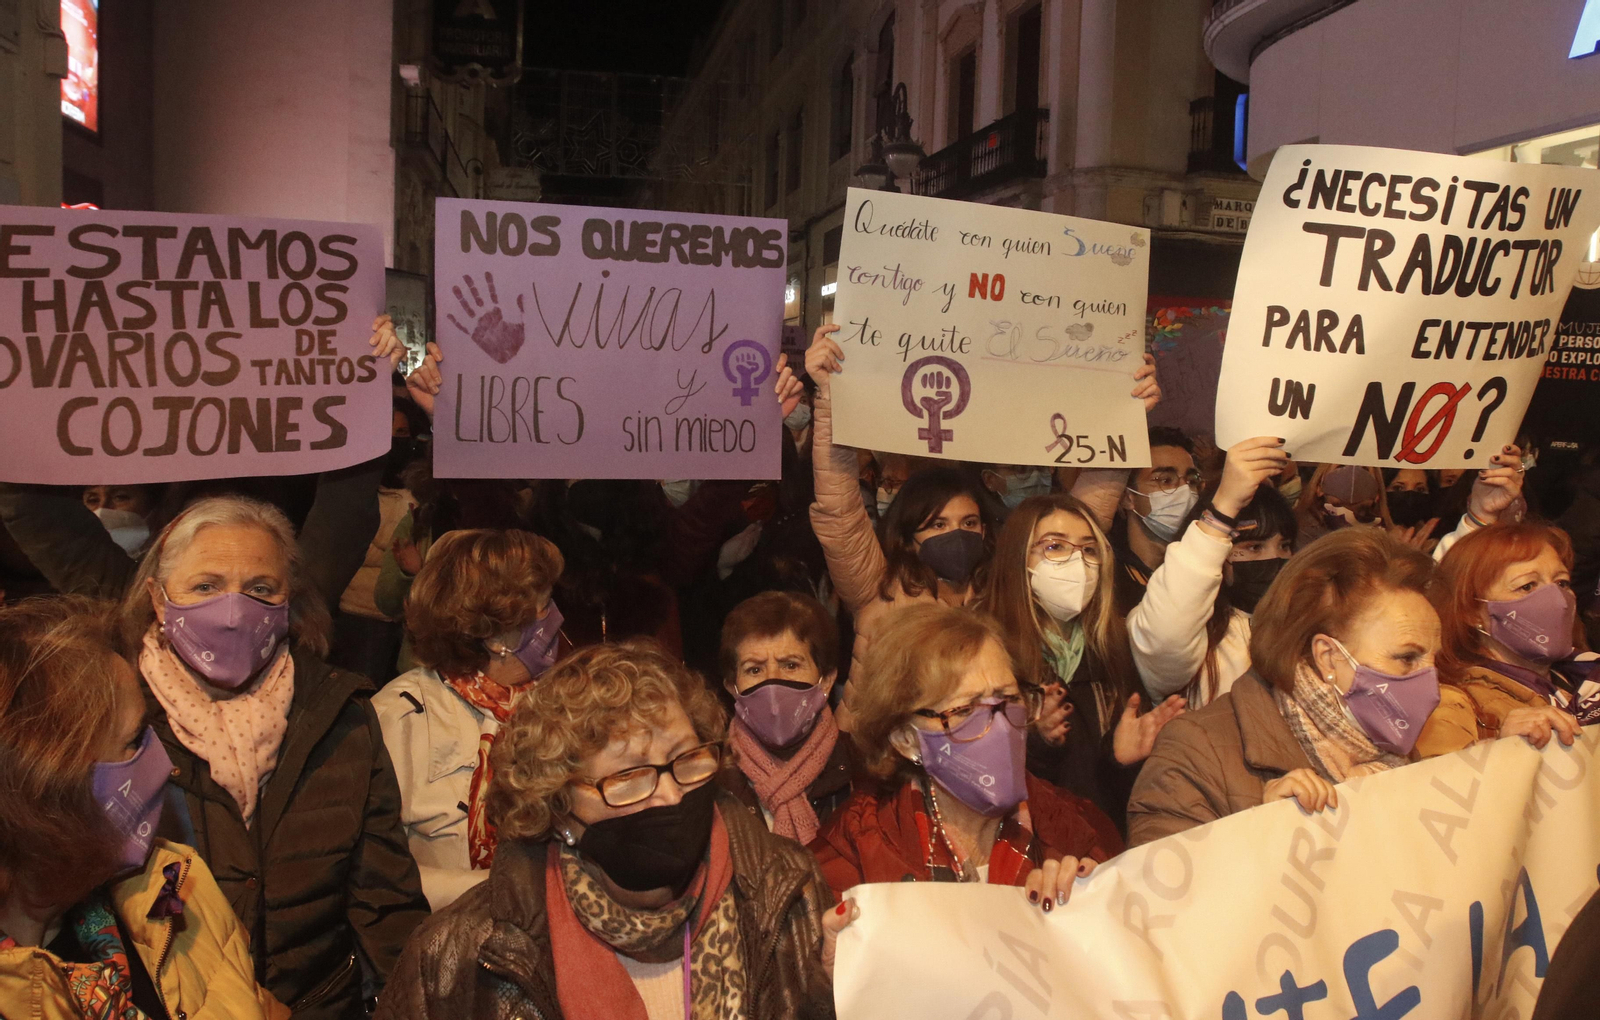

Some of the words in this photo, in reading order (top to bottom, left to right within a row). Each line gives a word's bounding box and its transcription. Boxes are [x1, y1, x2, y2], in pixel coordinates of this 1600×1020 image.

[1215, 216, 1235, 229] DE
[1544, 187, 1582, 230] UN
[0, 223, 359, 281] ESTAMOS
[460, 209, 562, 257] NOS
[581, 218, 785, 269] QUEREMOS
[958, 230, 992, 248] con
[1002, 237, 1051, 259] quien
[1302, 221, 1563, 300] TRADUCTOR
[22, 279, 235, 333] HASTA
[247, 281, 350, 328] LOS
[846, 263, 926, 306] contigo
[931, 281, 956, 314] y
[968, 272, 1006, 302] NO
[1019, 289, 1061, 309] con
[1073, 299, 1127, 319] quien
[295, 329, 338, 356] DE
[843, 316, 883, 347] te
[896, 325, 972, 362] quite
[1261, 304, 1366, 355] PARA
[1411, 318, 1551, 361] ENTENDER
[250, 354, 378, 386] TANTOS
[455, 373, 585, 445] LIBRES
[1267, 377, 1316, 420] UN
[57, 395, 349, 457] COJONES
[622, 411, 663, 453] sin
[1053, 433, 1128, 464] 25-N
